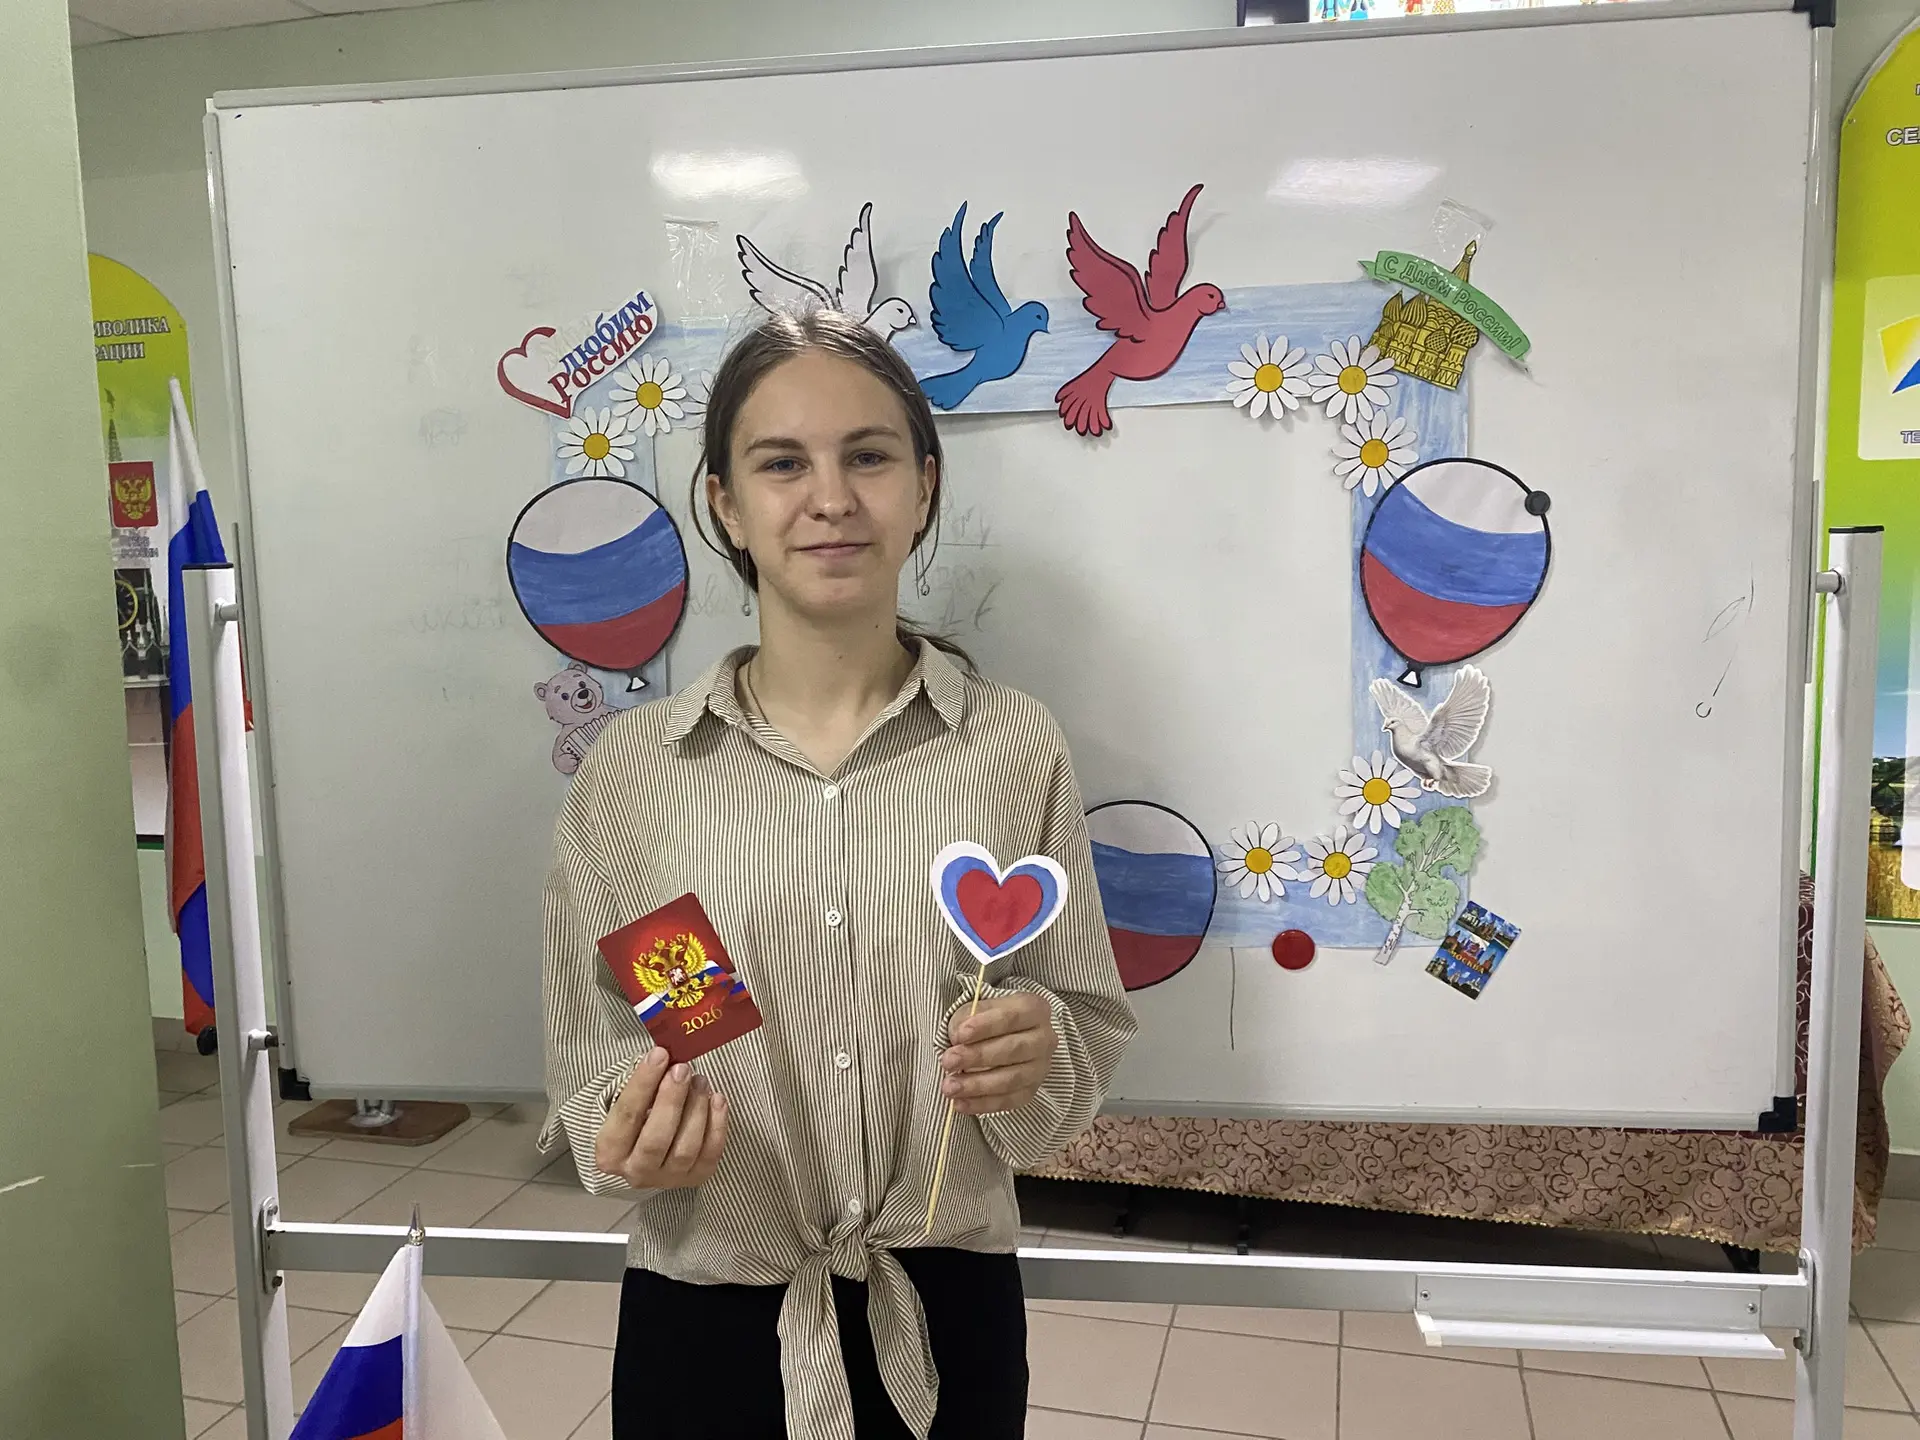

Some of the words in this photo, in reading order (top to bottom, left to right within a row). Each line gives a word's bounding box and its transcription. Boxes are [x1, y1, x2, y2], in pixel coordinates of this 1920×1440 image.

[1886, 127, 1920, 146] СЕ
[1384, 256, 1399, 274] С
[1453, 288, 1522, 351] России!
[681, 1004, 723, 1035] 2026
